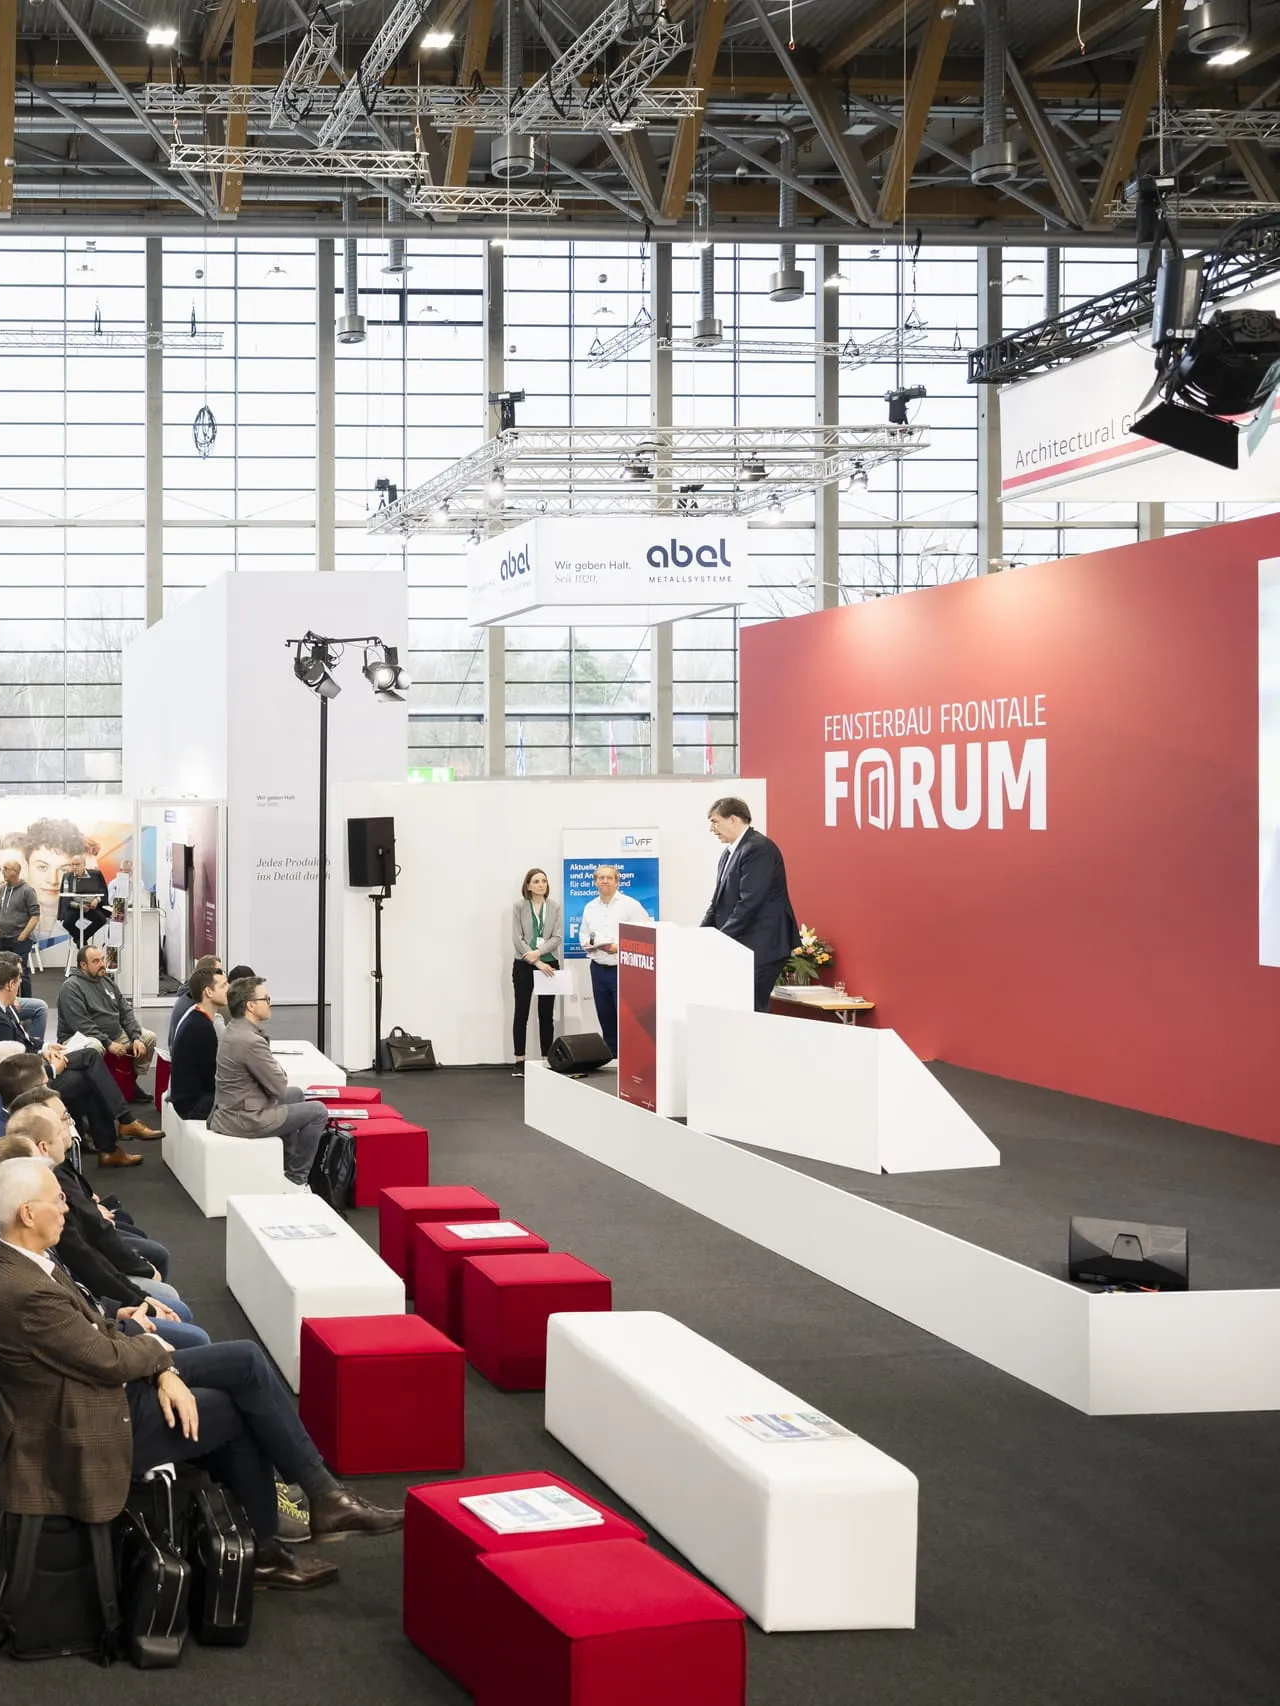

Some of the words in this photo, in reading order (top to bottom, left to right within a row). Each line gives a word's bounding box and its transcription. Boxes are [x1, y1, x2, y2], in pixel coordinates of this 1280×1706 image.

[1015, 418, 1116, 469] Architectural
[646, 538, 732, 568] abel
[500, 543, 531, 581] abel
[554, 560, 571, 570] Wir
[574, 559, 606, 572] geben
[609, 560, 632, 571] Halt.
[648, 575, 733, 583] METALLSYSTEME
[824, 705, 932, 742] FENSTERBAU
[940, 693, 1047, 733] FRONTALE
[824, 738, 1047, 831] FORUM
[634, 838, 653, 846] VFF
[256, 859, 283, 868] Jedes
[285, 858, 320, 867] Produk
[274, 872, 301, 880] Detail
[570, 871, 584, 879] und
